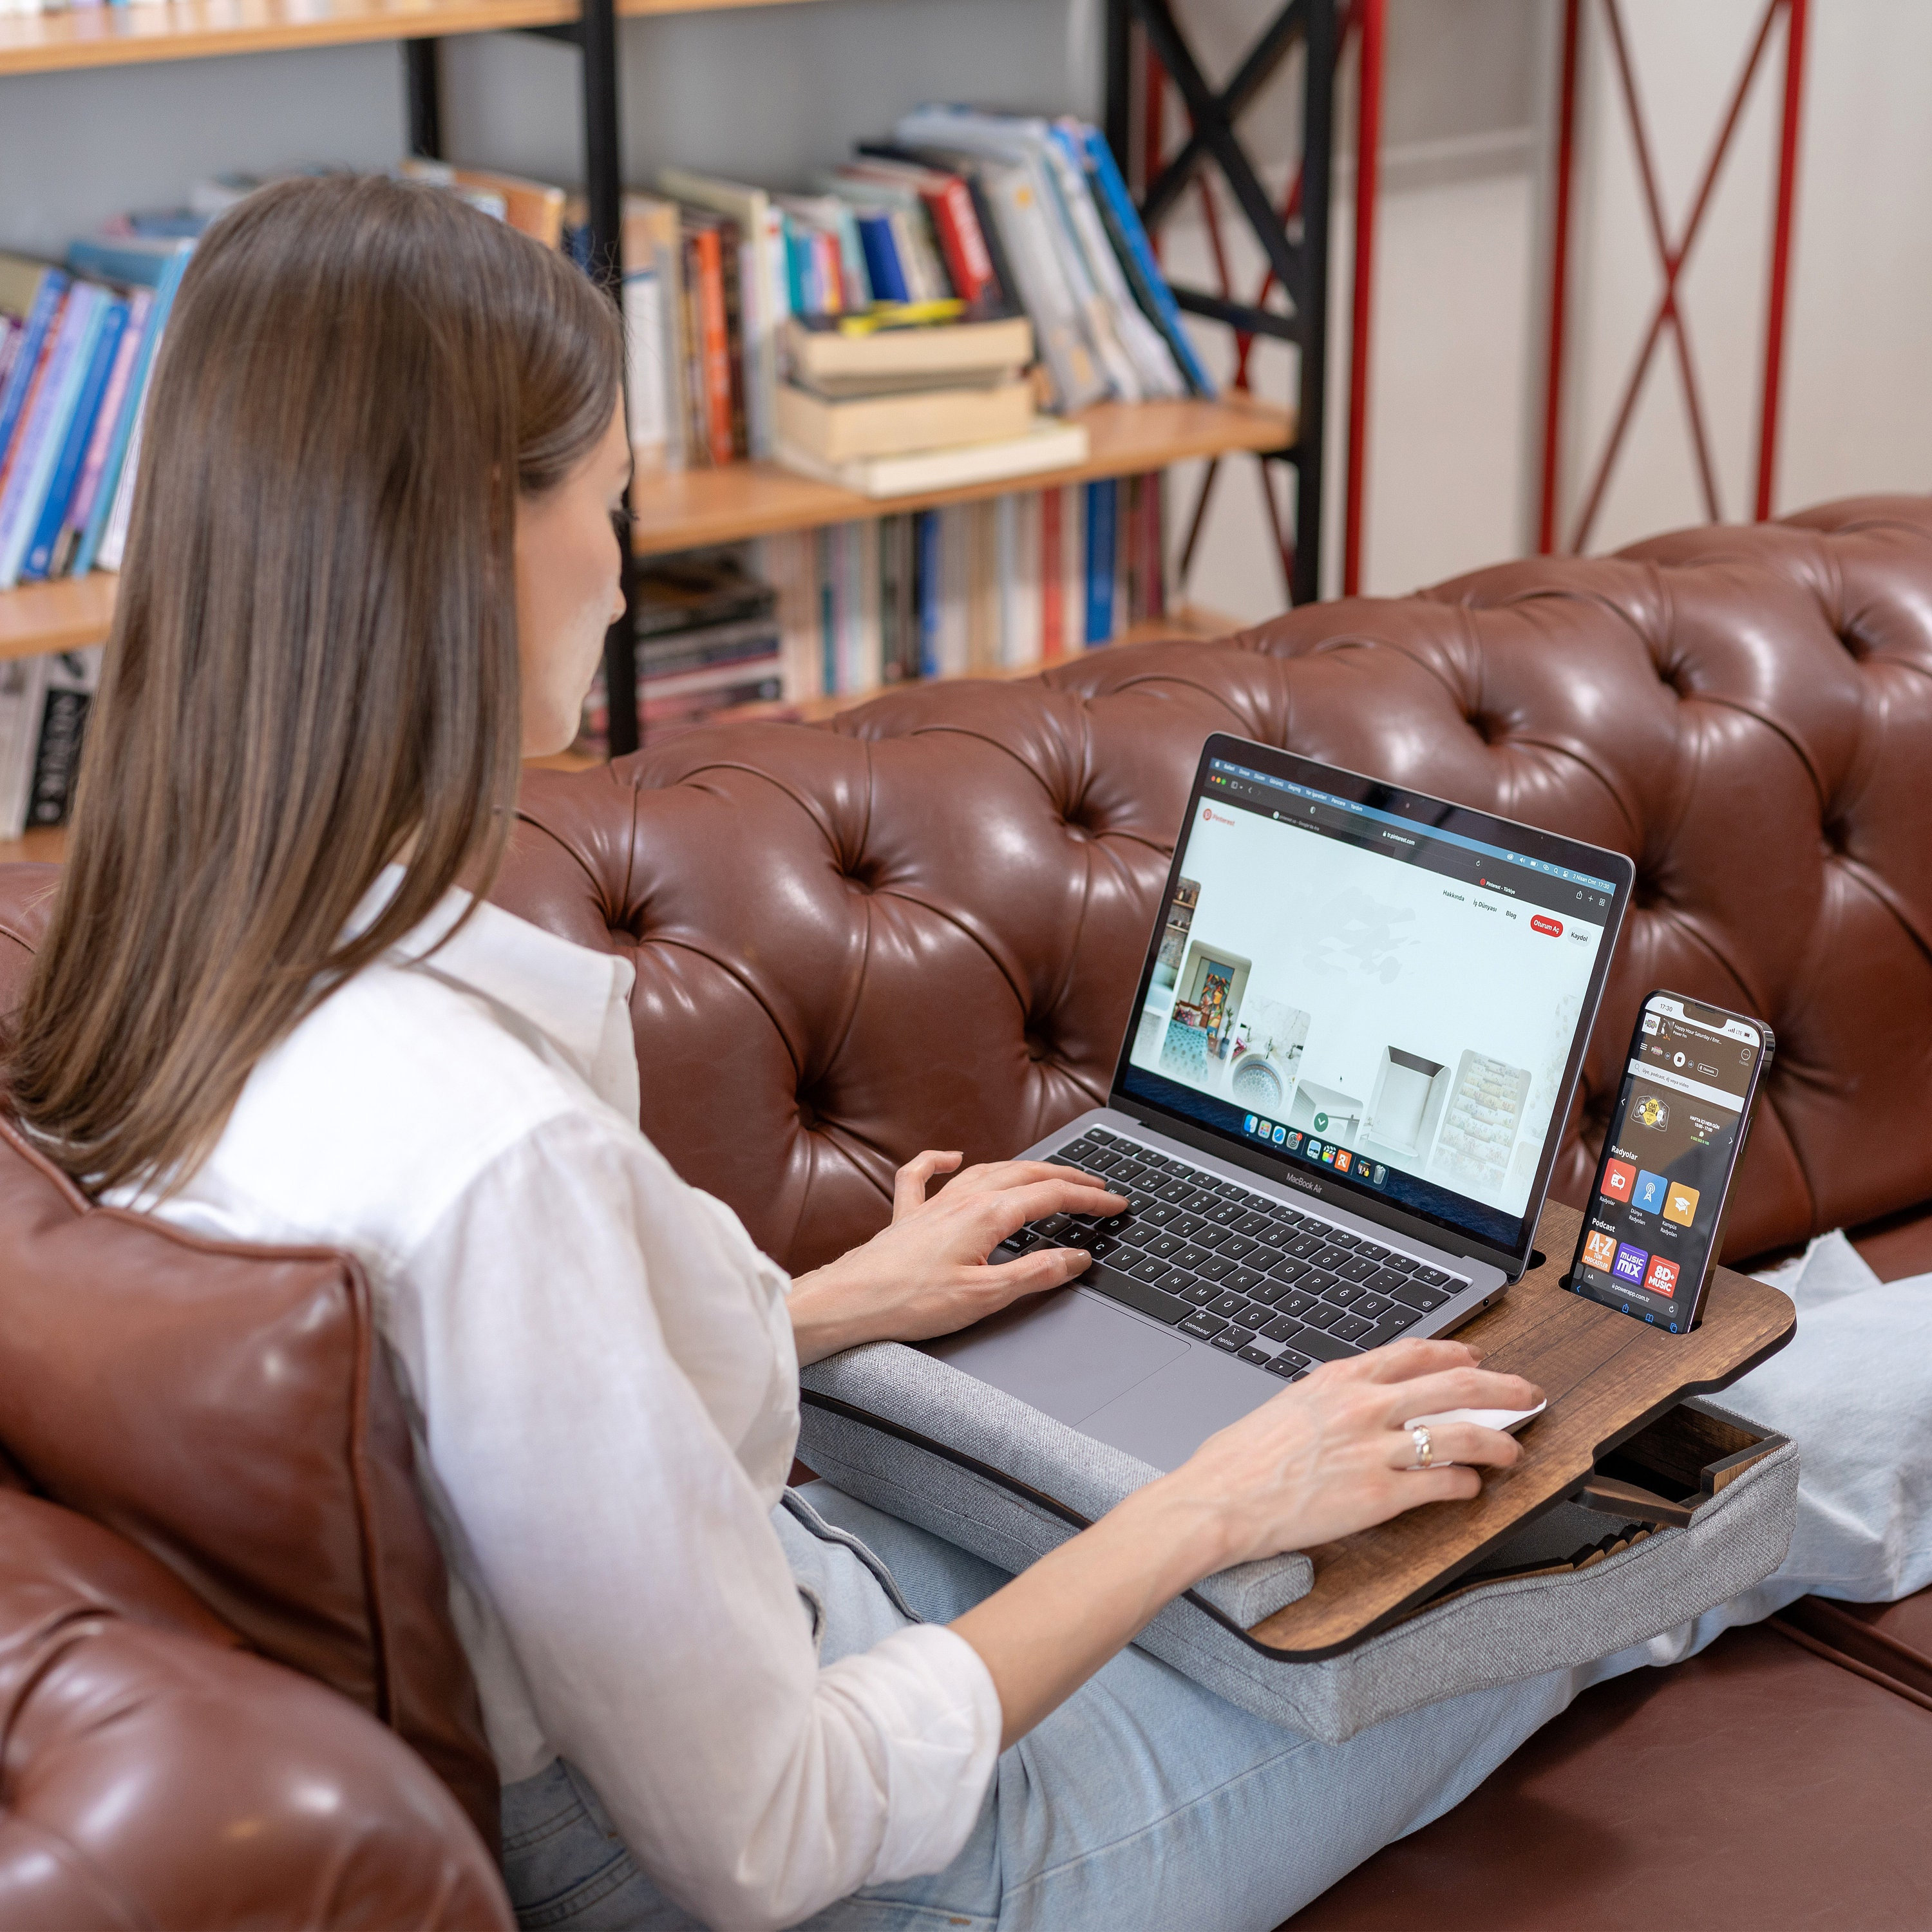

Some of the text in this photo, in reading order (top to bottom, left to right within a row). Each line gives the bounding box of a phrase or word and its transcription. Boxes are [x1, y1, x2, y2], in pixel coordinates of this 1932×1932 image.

[1331, 797, 1346, 806] Pencere
[1387, 832, 1415, 846] tr.pinterest.com
[1486, 881, 1501, 889] Pinterest
[1503, 886, 1515, 895] Türkiye
[1443, 890, 1465, 902] Hakkında
[1473, 898, 1497, 913] İş Dünyası
[1506, 910, 1517, 920] Blog
[1533, 920, 1560, 934] Oturum Aç
[1571, 932, 1588, 942] Kaydol
[1660, 1003, 1673, 1012] 17:30
[1674, 1024, 1685, 1032] Happy
[1694, 1031, 1710, 1041] Saturday
[1650, 1072, 1665, 1081] podcast,
[1611, 1145, 1638, 1160] Radyolar
[1287, 1173, 1322, 1193] MacBook Air
[1599, 1196, 1616, 1206] Radyolar
[1630, 1208, 1643, 1217] Dünya
[1591, 1218, 1616, 1233] Podcast
[1629, 1215, 1646, 1226] Radyoları
[1662, 1220, 1678, 1230] Kampüs
[1660, 1227, 1678, 1238] Radyoları
[1005, 1239, 1020, 1247] option
[1587, 1233, 1613, 1257] A-Z
[1584, 1255, 1608, 1269] PODCASTLER
[1594, 1252, 1603, 1260] TÜM
[1654, 1265, 1674, 1281] 8D+
[1648, 1276, 1672, 1292] MUSIC
[1615, 1285, 1650, 1302] powerapp.com.tr
[1185, 1321, 1210, 1335] command
[1218, 1336, 1235, 1347] option
